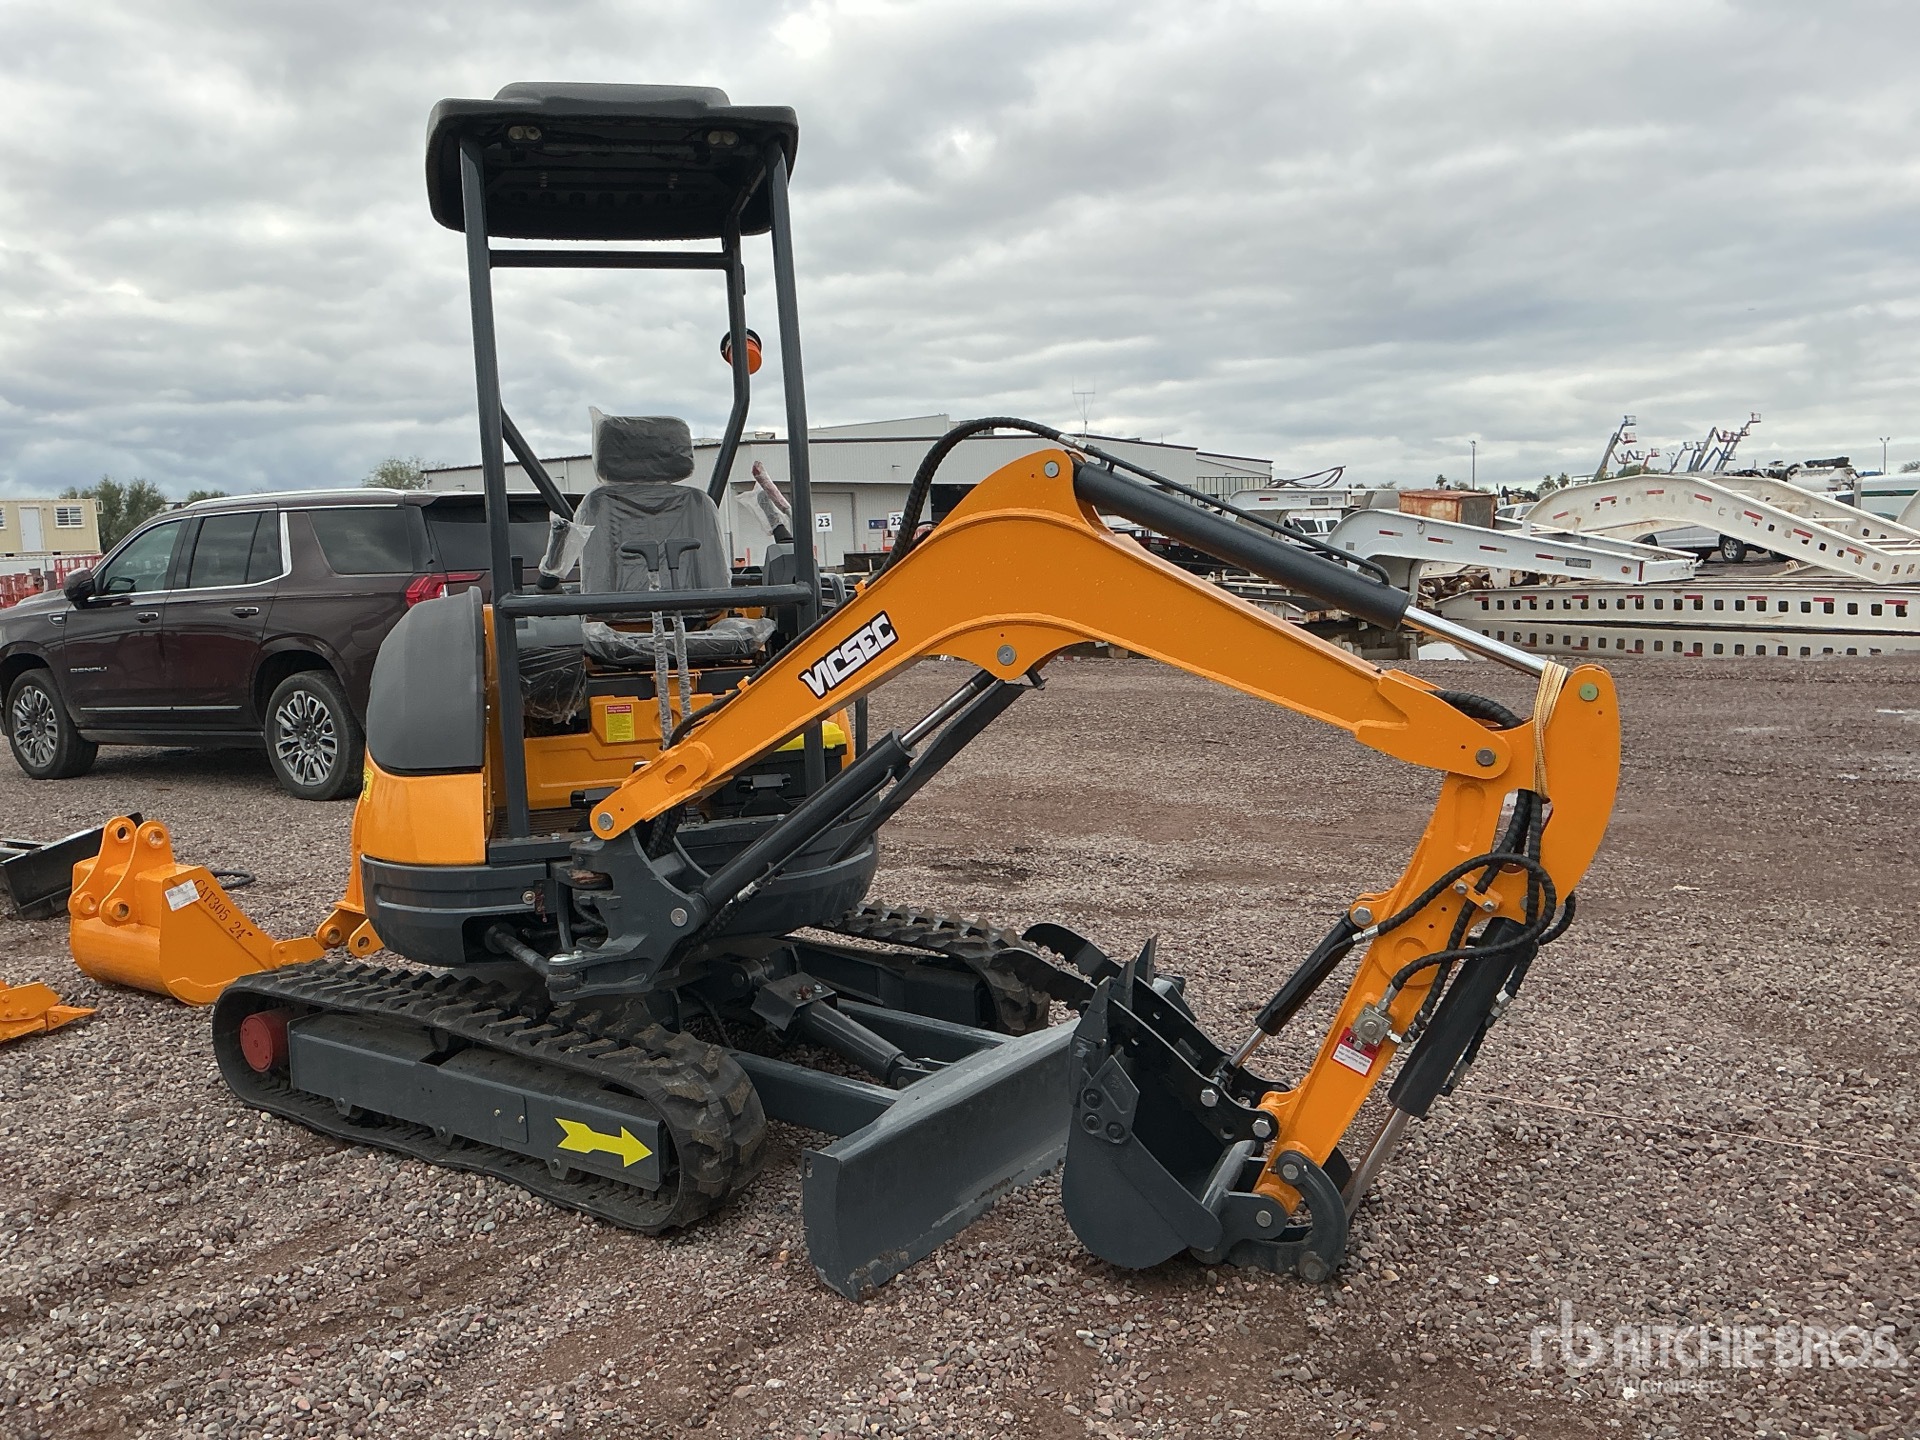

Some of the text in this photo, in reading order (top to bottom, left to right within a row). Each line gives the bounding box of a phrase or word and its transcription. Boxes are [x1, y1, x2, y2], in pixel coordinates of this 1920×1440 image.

[818, 518, 830, 527] 23
[891, 517, 902, 526] 22
[799, 611, 898, 698] VICSEC
[195, 879, 231, 921] CAT305
